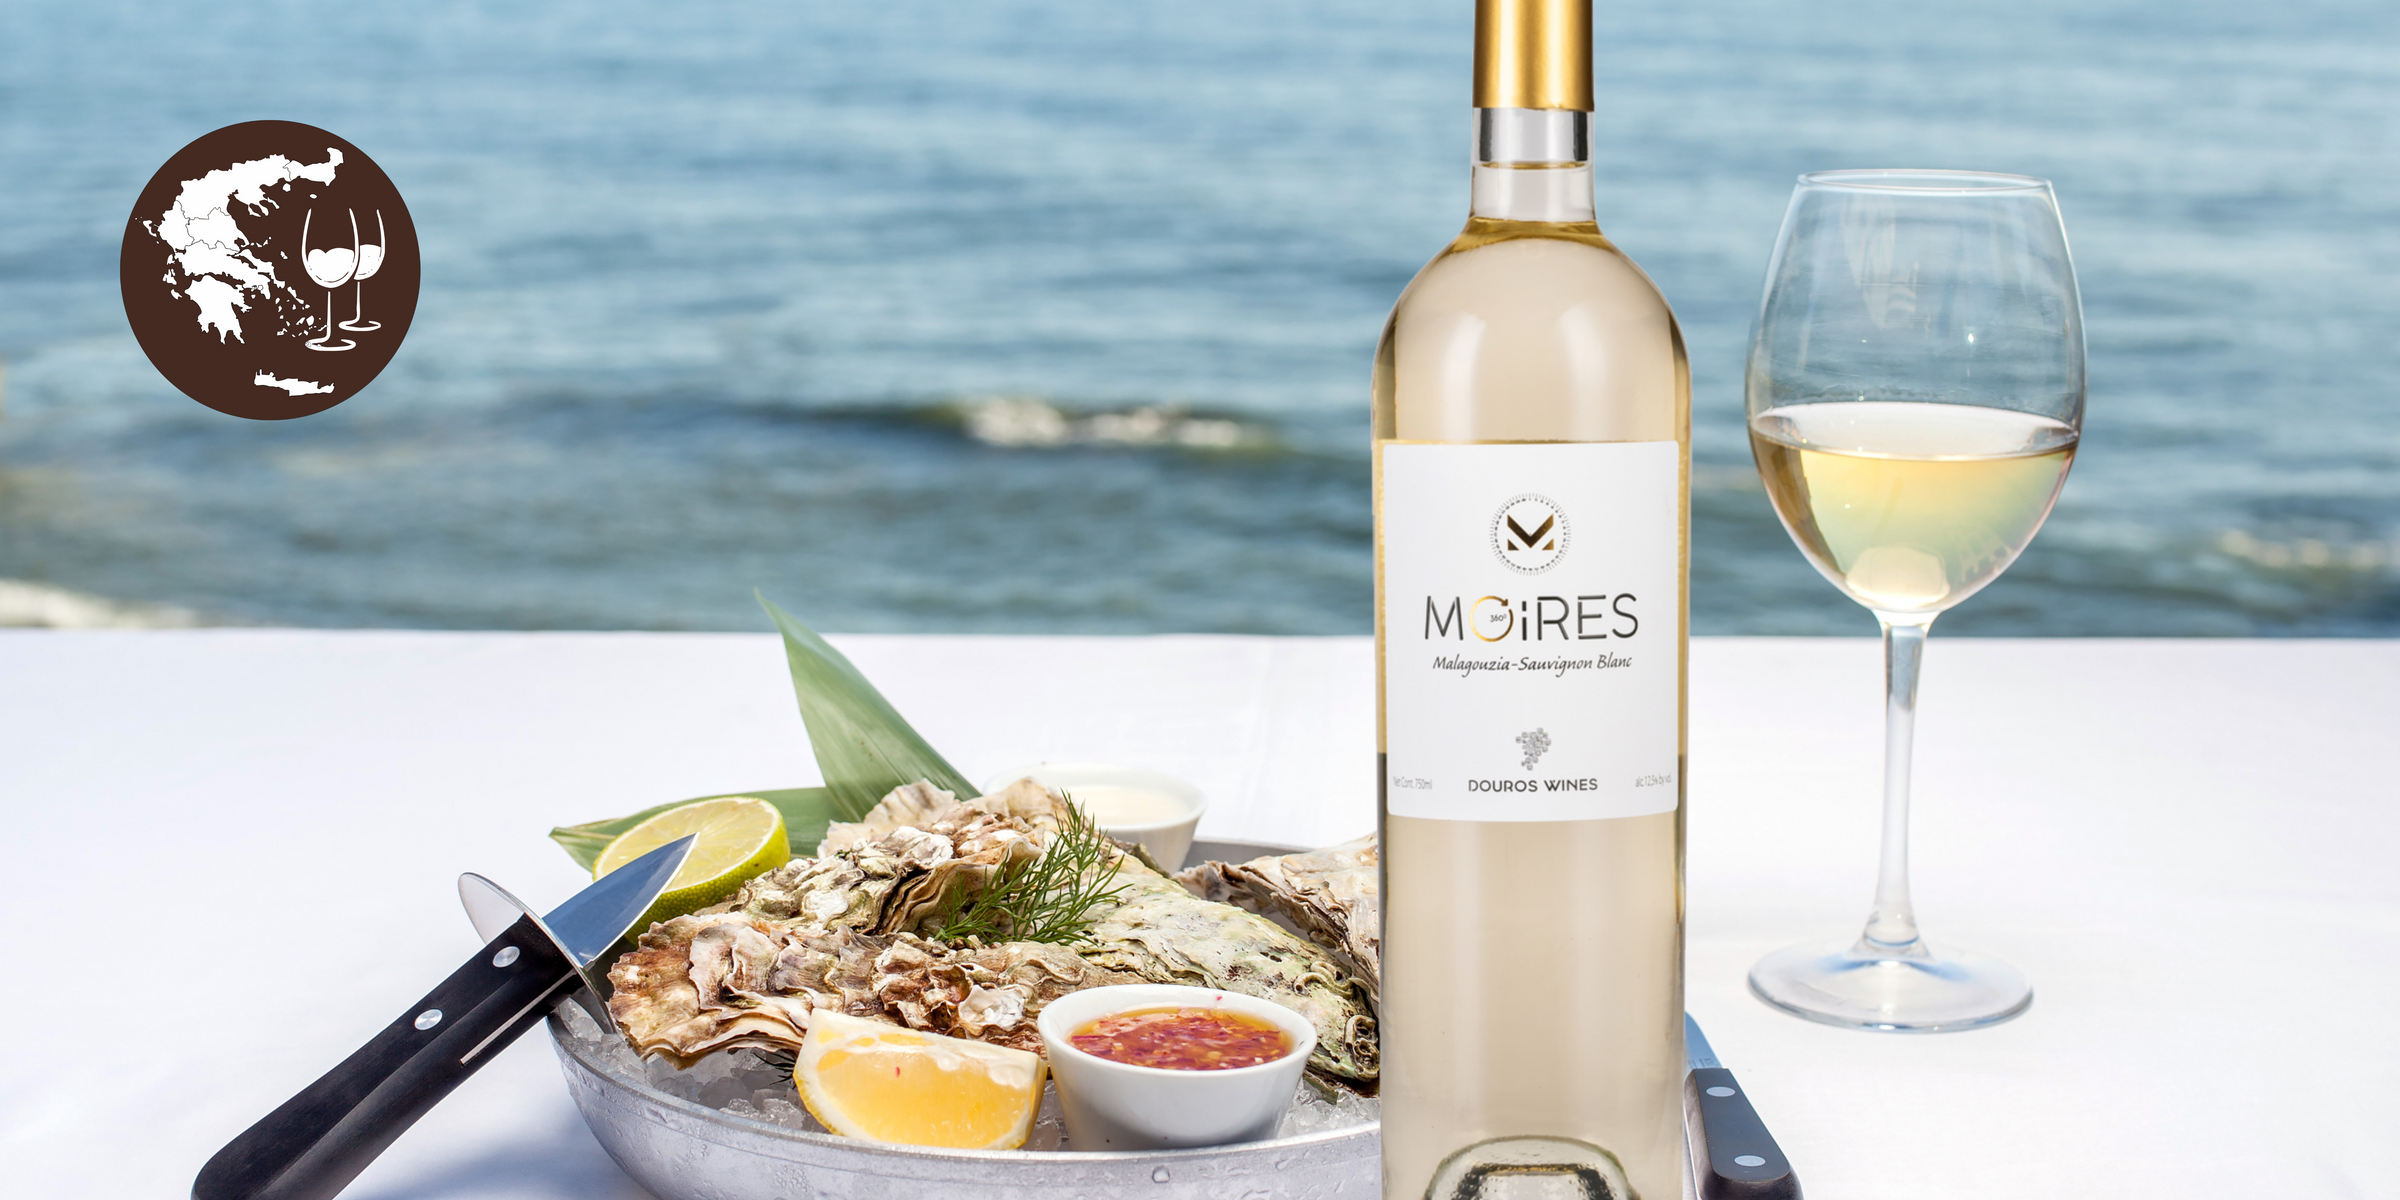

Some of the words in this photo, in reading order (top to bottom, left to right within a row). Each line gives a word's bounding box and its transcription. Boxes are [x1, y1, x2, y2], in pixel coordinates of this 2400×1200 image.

[1432, 653, 1593, 678] Malagouzia-Sauvignon
[1597, 651, 1633, 669] Blanc
[1468, 779, 1538, 793] DOUROS
[1544, 778, 1599, 792] WINES
